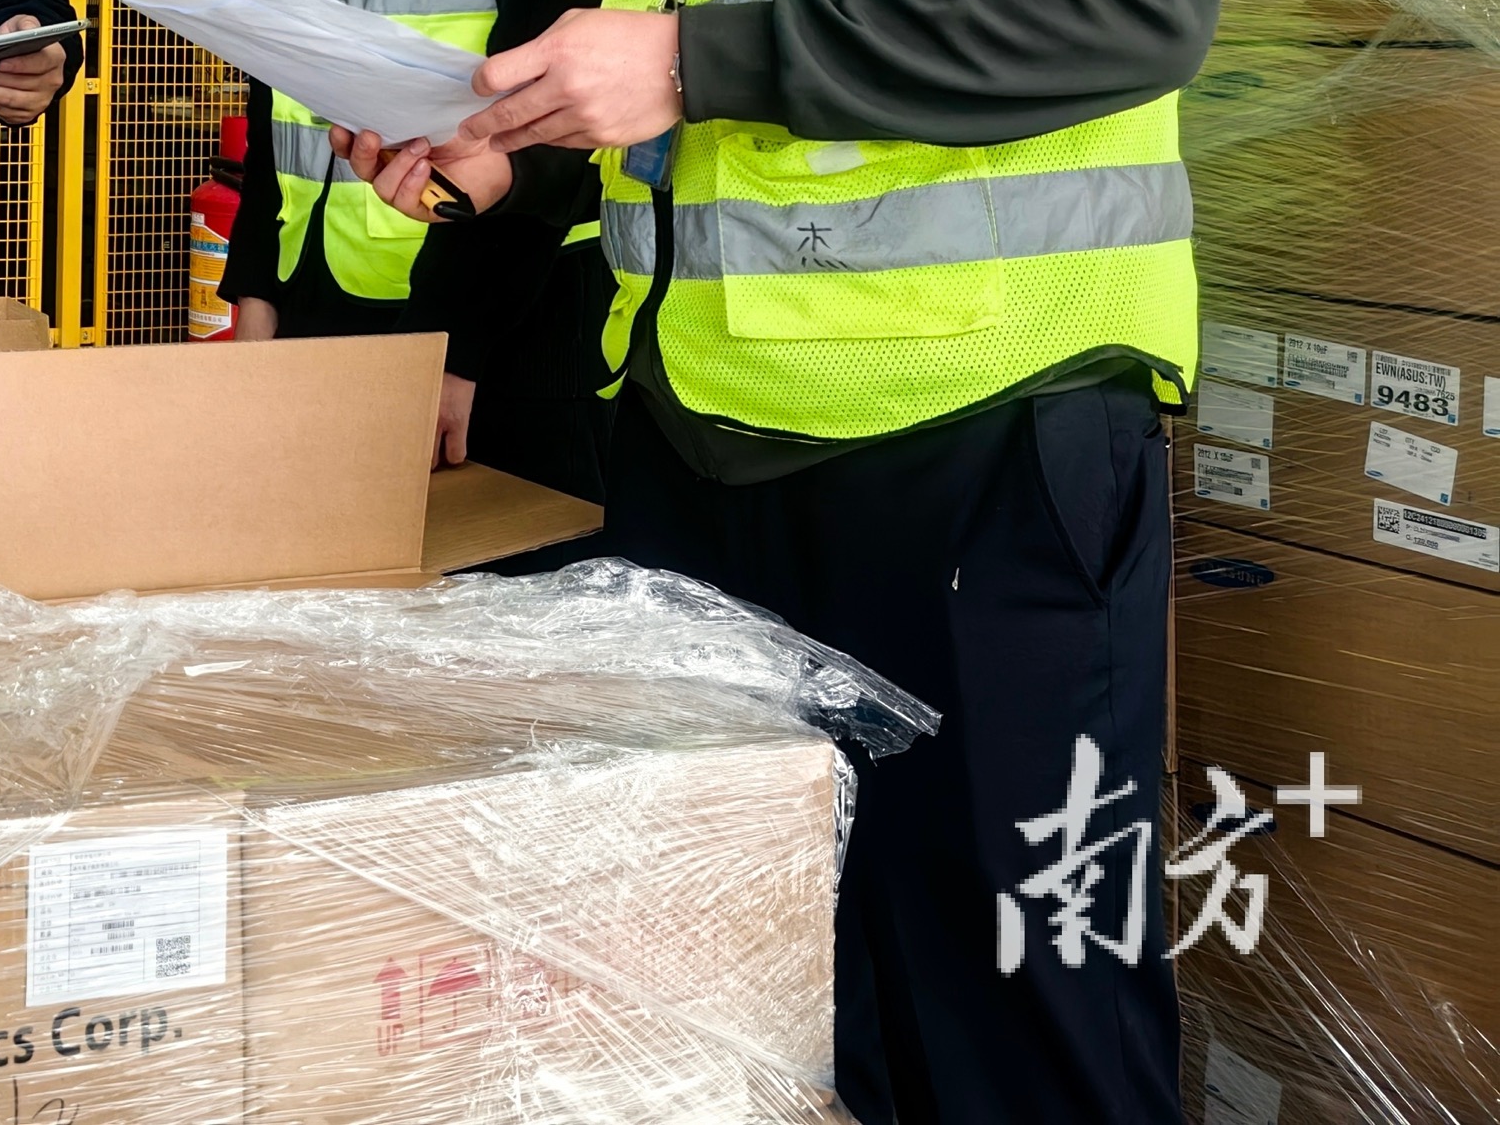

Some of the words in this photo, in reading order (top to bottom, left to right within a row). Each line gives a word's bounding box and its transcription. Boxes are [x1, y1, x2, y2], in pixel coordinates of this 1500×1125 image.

[796, 221, 848, 270] 杰
[1377, 385, 1449, 417] 9483
[51, 1006, 183, 1058] Corp.
